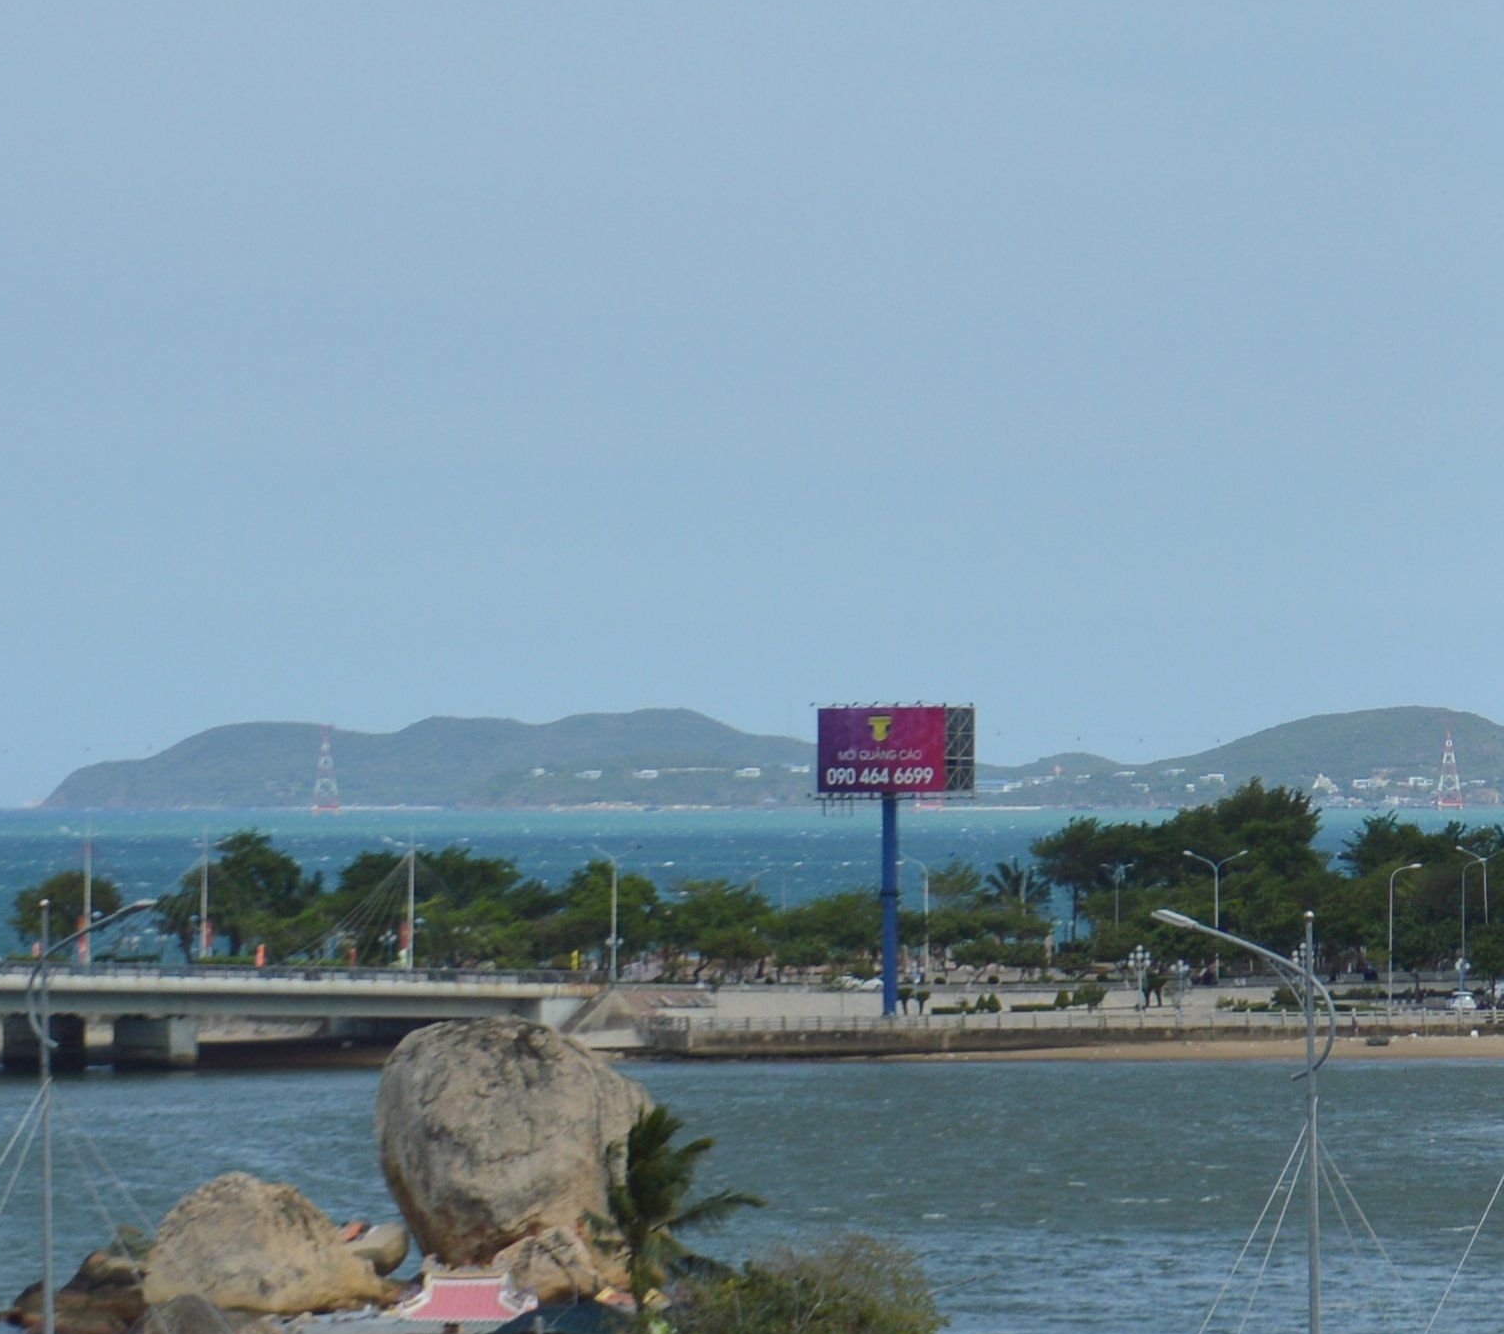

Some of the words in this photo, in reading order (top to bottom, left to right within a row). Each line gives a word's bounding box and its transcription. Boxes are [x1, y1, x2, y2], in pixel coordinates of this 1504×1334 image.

[859, 746, 897, 760] QUẢNG
[899, 747, 922, 760] CÁO
[826, 767, 856, 785] 090
[859, 767, 889, 784] 464
[893, 767, 934, 785] 6699
